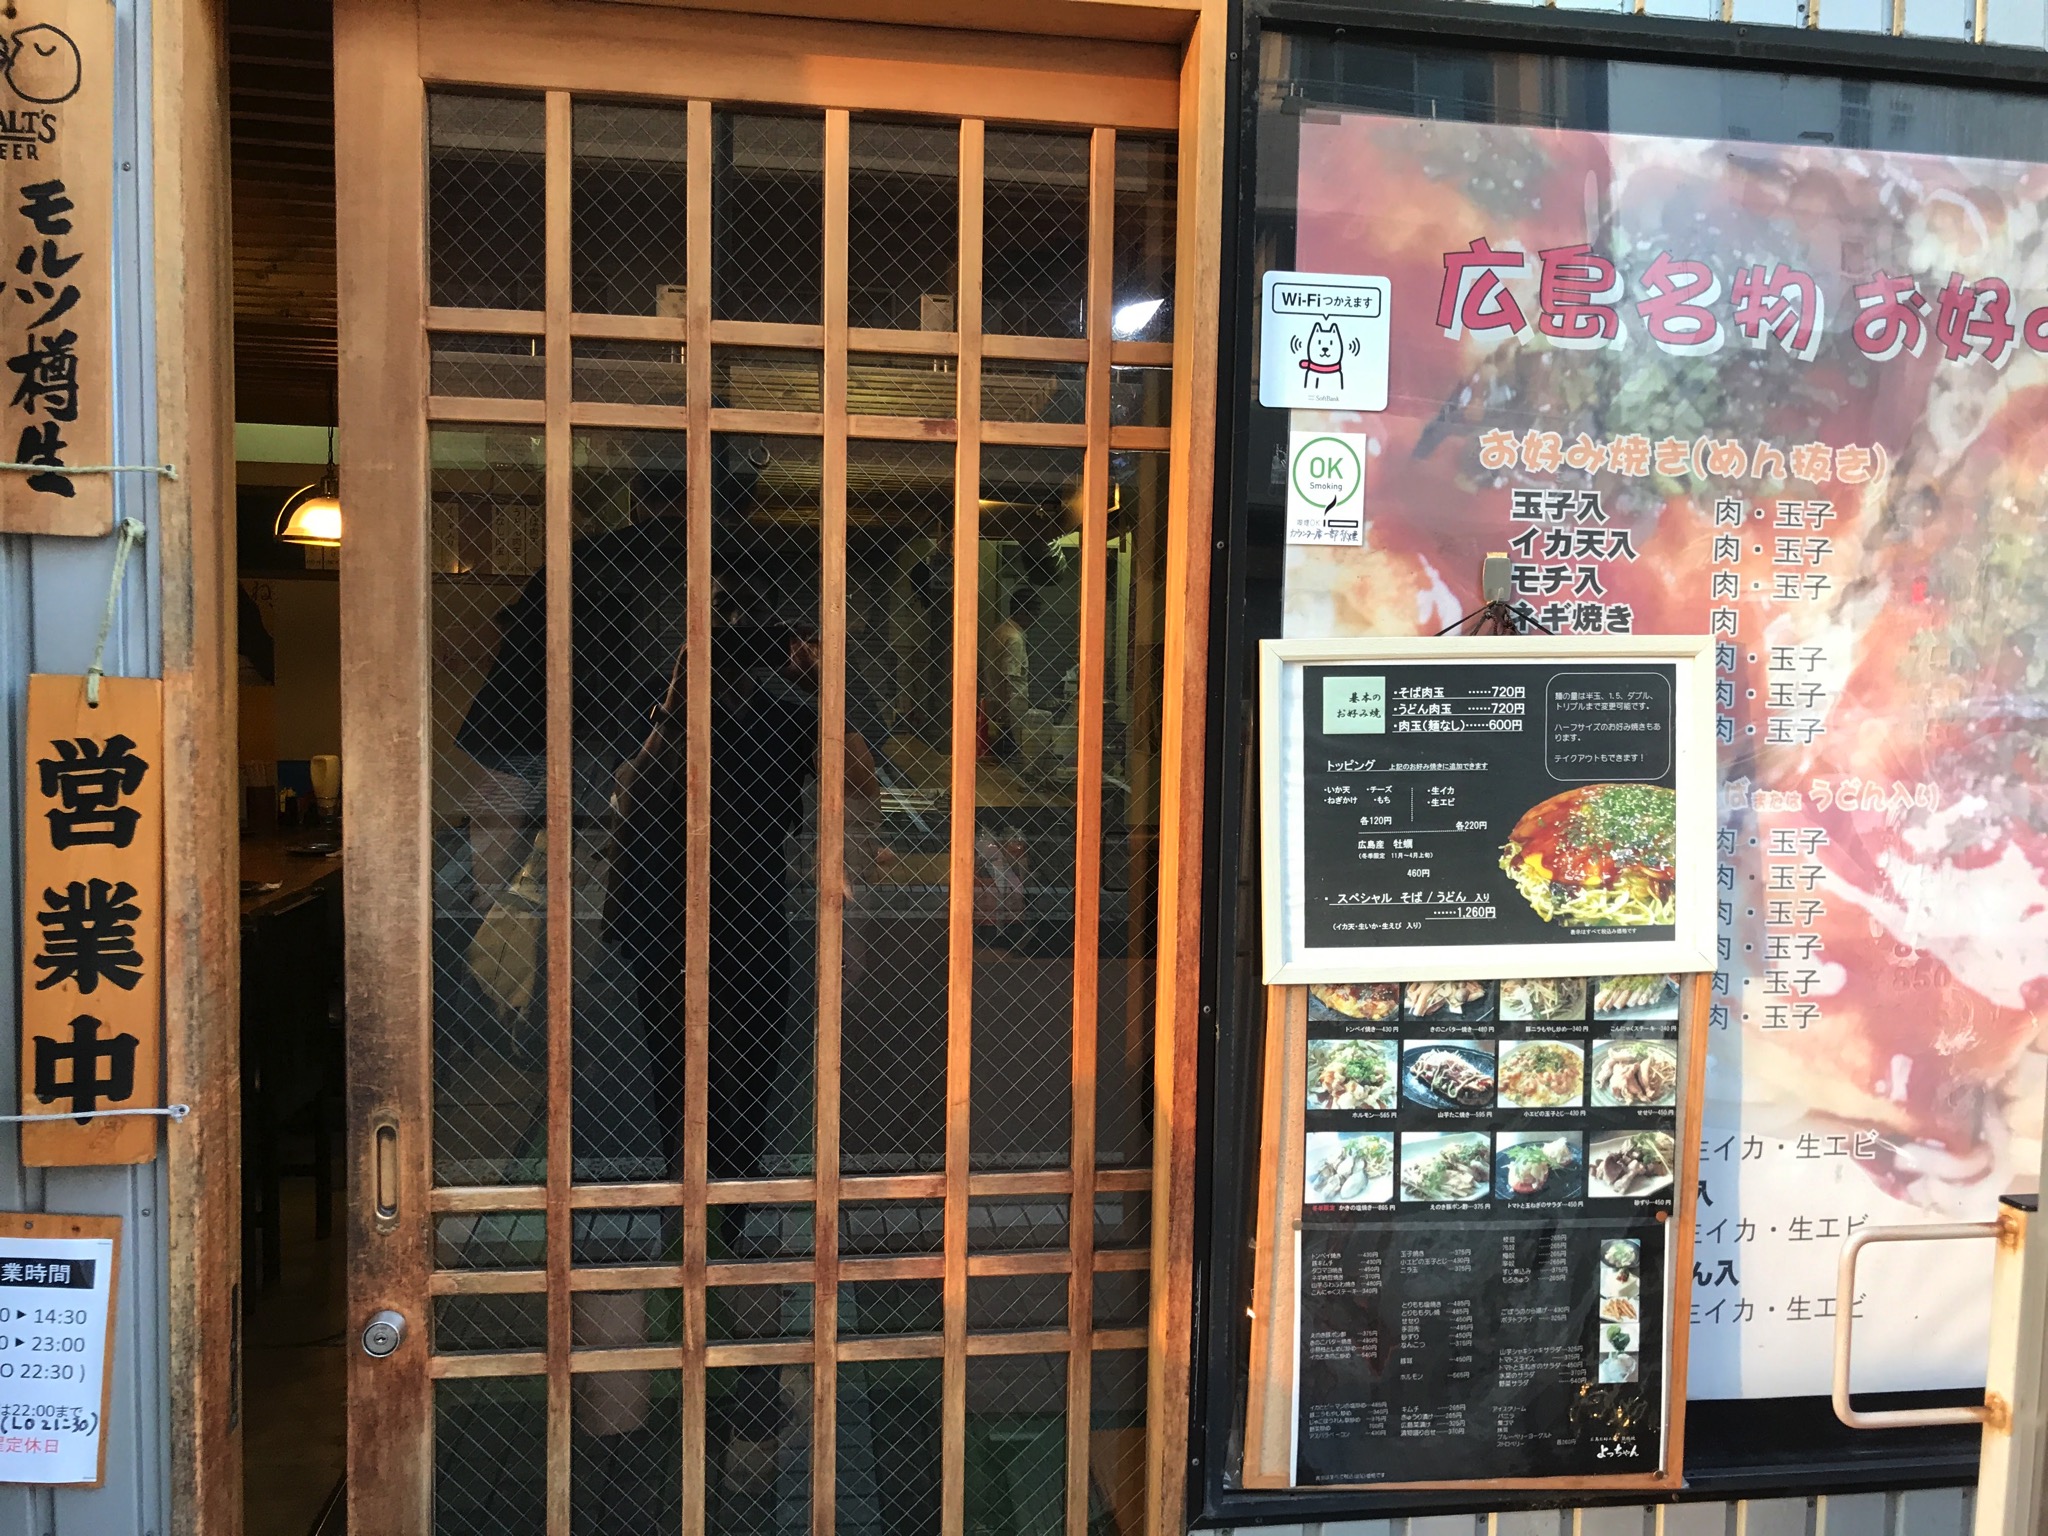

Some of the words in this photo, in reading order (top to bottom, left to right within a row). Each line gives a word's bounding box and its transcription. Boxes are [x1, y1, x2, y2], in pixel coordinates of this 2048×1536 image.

[1436, 237, 1822, 360] 広島名物
[0, 179, 83, 498] モルツ樽生
[1479, 429, 1888, 485] お好み焼き(めん抜き)
[1310, 456, 1343, 480] OK
[1310, 482, 1343, 491] Smoking
[1511, 489, 1609, 524] 玉子入
[1715, 498, 1836, 528] 肉・玉子
[1511, 527, 1638, 562] イカ天入
[1713, 536, 1834, 566] 肉・玉子
[1512, 565, 1606, 596] モチ入
[1711, 573, 1832, 602] 肉・玉子
[1511, 601, 1632, 633] ネギ焼き
[1711, 609, 1737, 635] 肉
[1349, 692, 1381, 703] 基本の
[1492, 686, 1526, 698] 720円
[1336, 708, 1382, 719] お好み焼
[1492, 703, 1525, 714] 720円
[1556, 702, 1650, 711] トリプルまで変更可能です。
[1489, 719, 1523, 731] 600円
[1554, 723, 1661, 731] ハーフサイズのお好み焼きもあ
[1554, 734, 1581, 742] ります。
[1328, 760, 1376, 771] トッピング
[1388, 762, 1489, 771] 上記のお好み焼きに追加できます
[1809, 777, 1940, 812] うどん入り
[1360, 816, 1392, 826] 各120円
[1456, 821, 1488, 830] 各220円
[1357, 840, 1385, 850] 広島産
[1407, 869, 1430, 878] 460円
[1337, 892, 1392, 904] スペシャル
[1400, 892, 1423, 903] そば
[1436, 891, 1467, 903] うどん
[1475, 893, 1490, 903] 入り
[1457, 907, 1497, 919] 1,260円
[33, 735, 149, 1124] 営業中
[1, 1262, 71, 1284] 業時間
[34, 1309, 87, 1325] 14:30
[31, 1336, 85, 1352] 23:00
[20, 1364, 73, 1380] 22:30
[1597, 1443, 1639, 1458] よっちゃん
